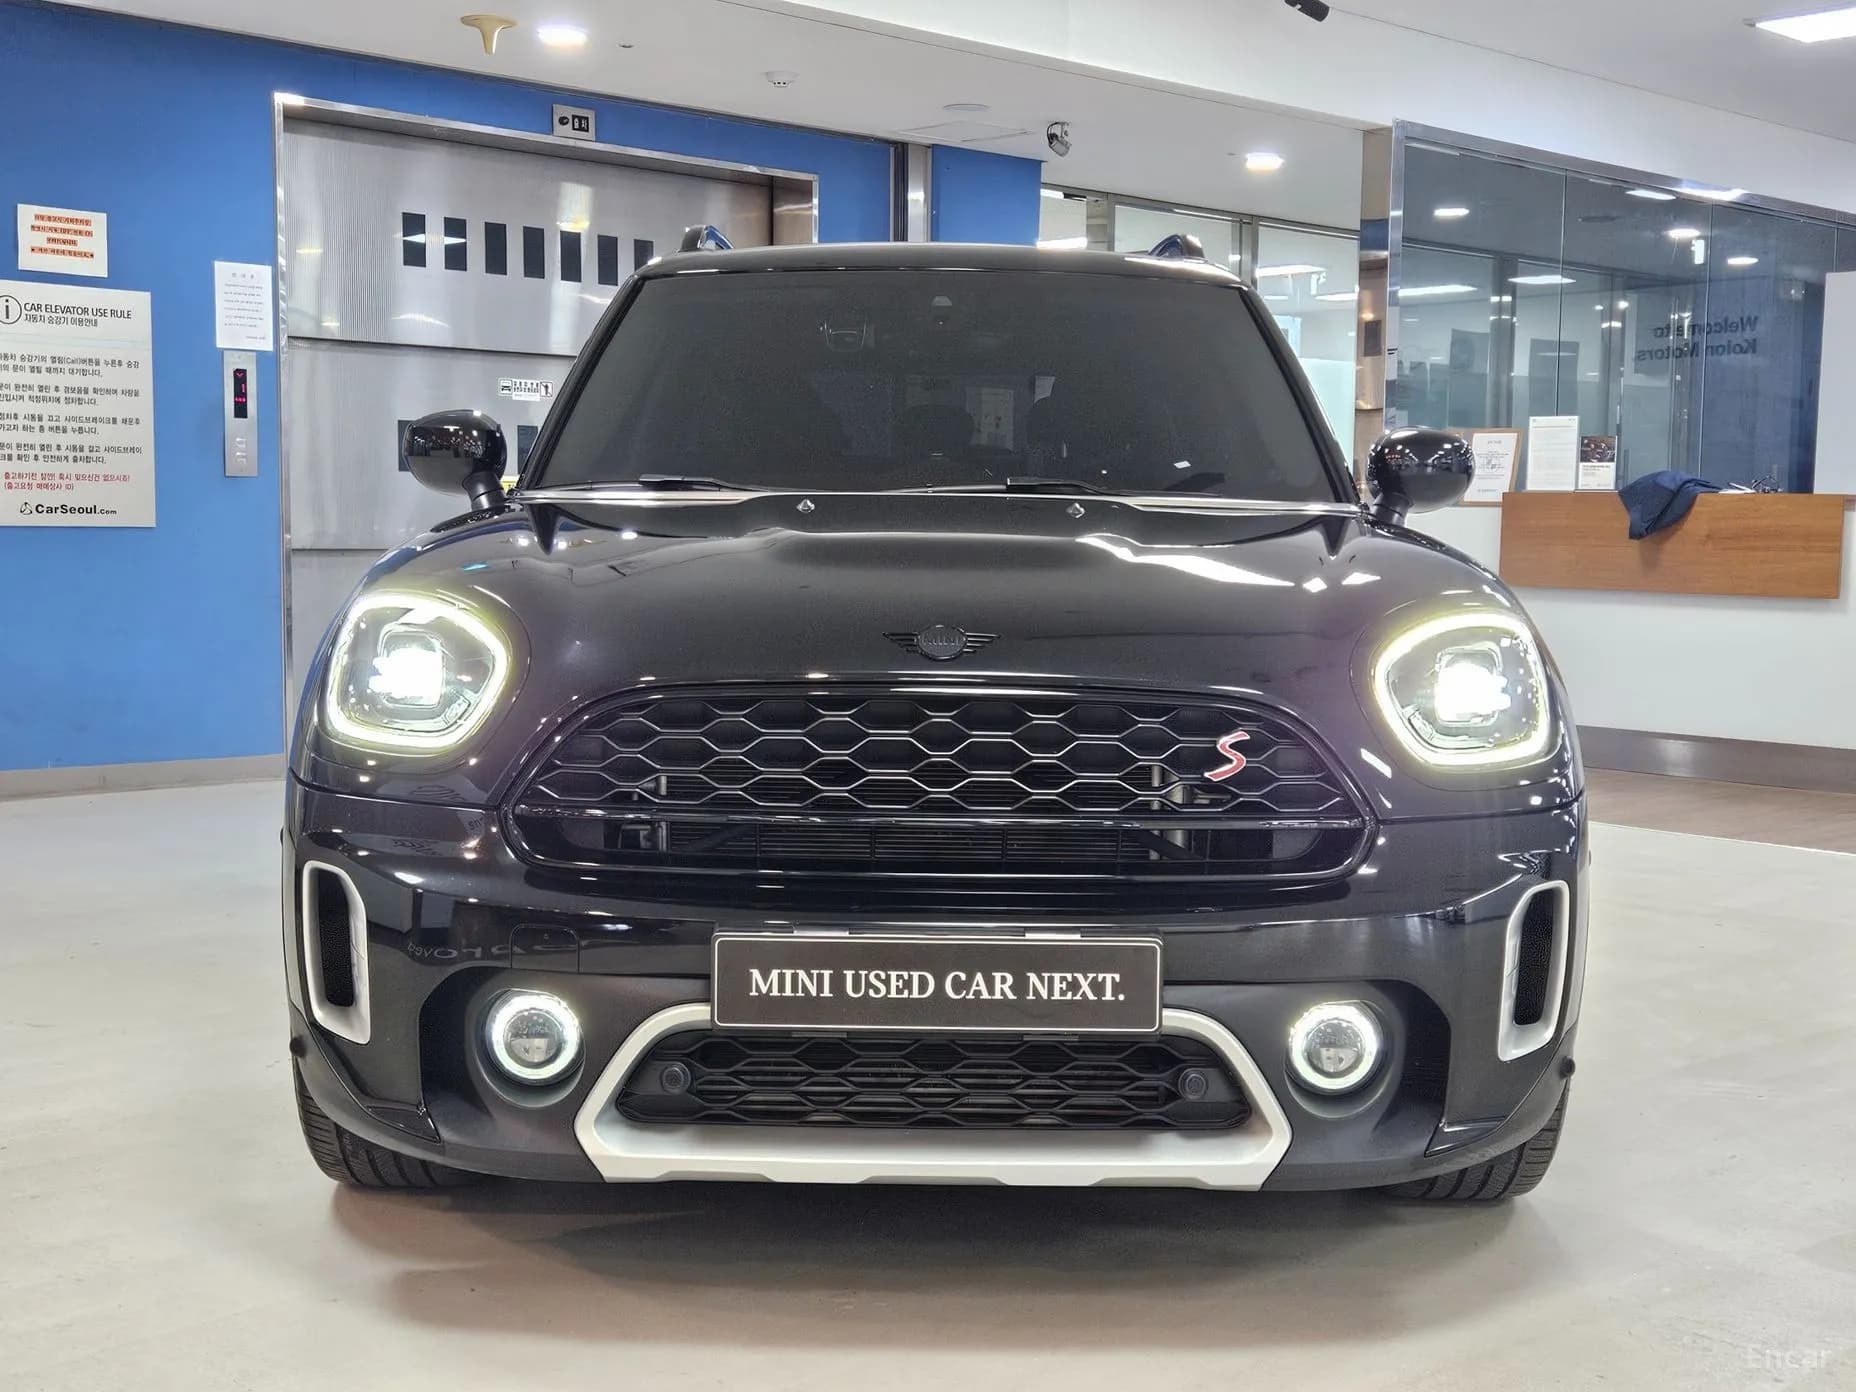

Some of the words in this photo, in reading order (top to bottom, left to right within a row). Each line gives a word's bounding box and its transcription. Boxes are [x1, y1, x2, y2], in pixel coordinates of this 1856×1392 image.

[24, 303, 42, 313] CAR
[45, 304, 89, 316] ELEVATOR
[92, 308, 108, 317] USE
[110, 309, 131, 319] RULE
[25, 314, 45, 323] 자동차
[48, 315, 68, 325] 승강기
[71, 317, 97, 327] 이용안내
[20, 354, 47, 363] 승강기의
[1203, 731, 1251, 782] S
[749, 969, 834, 998] MINI
[844, 971, 934, 999] USED
[944, 972, 1014, 1000] CAR
[1026, 972, 1125, 1001] NEXT.
